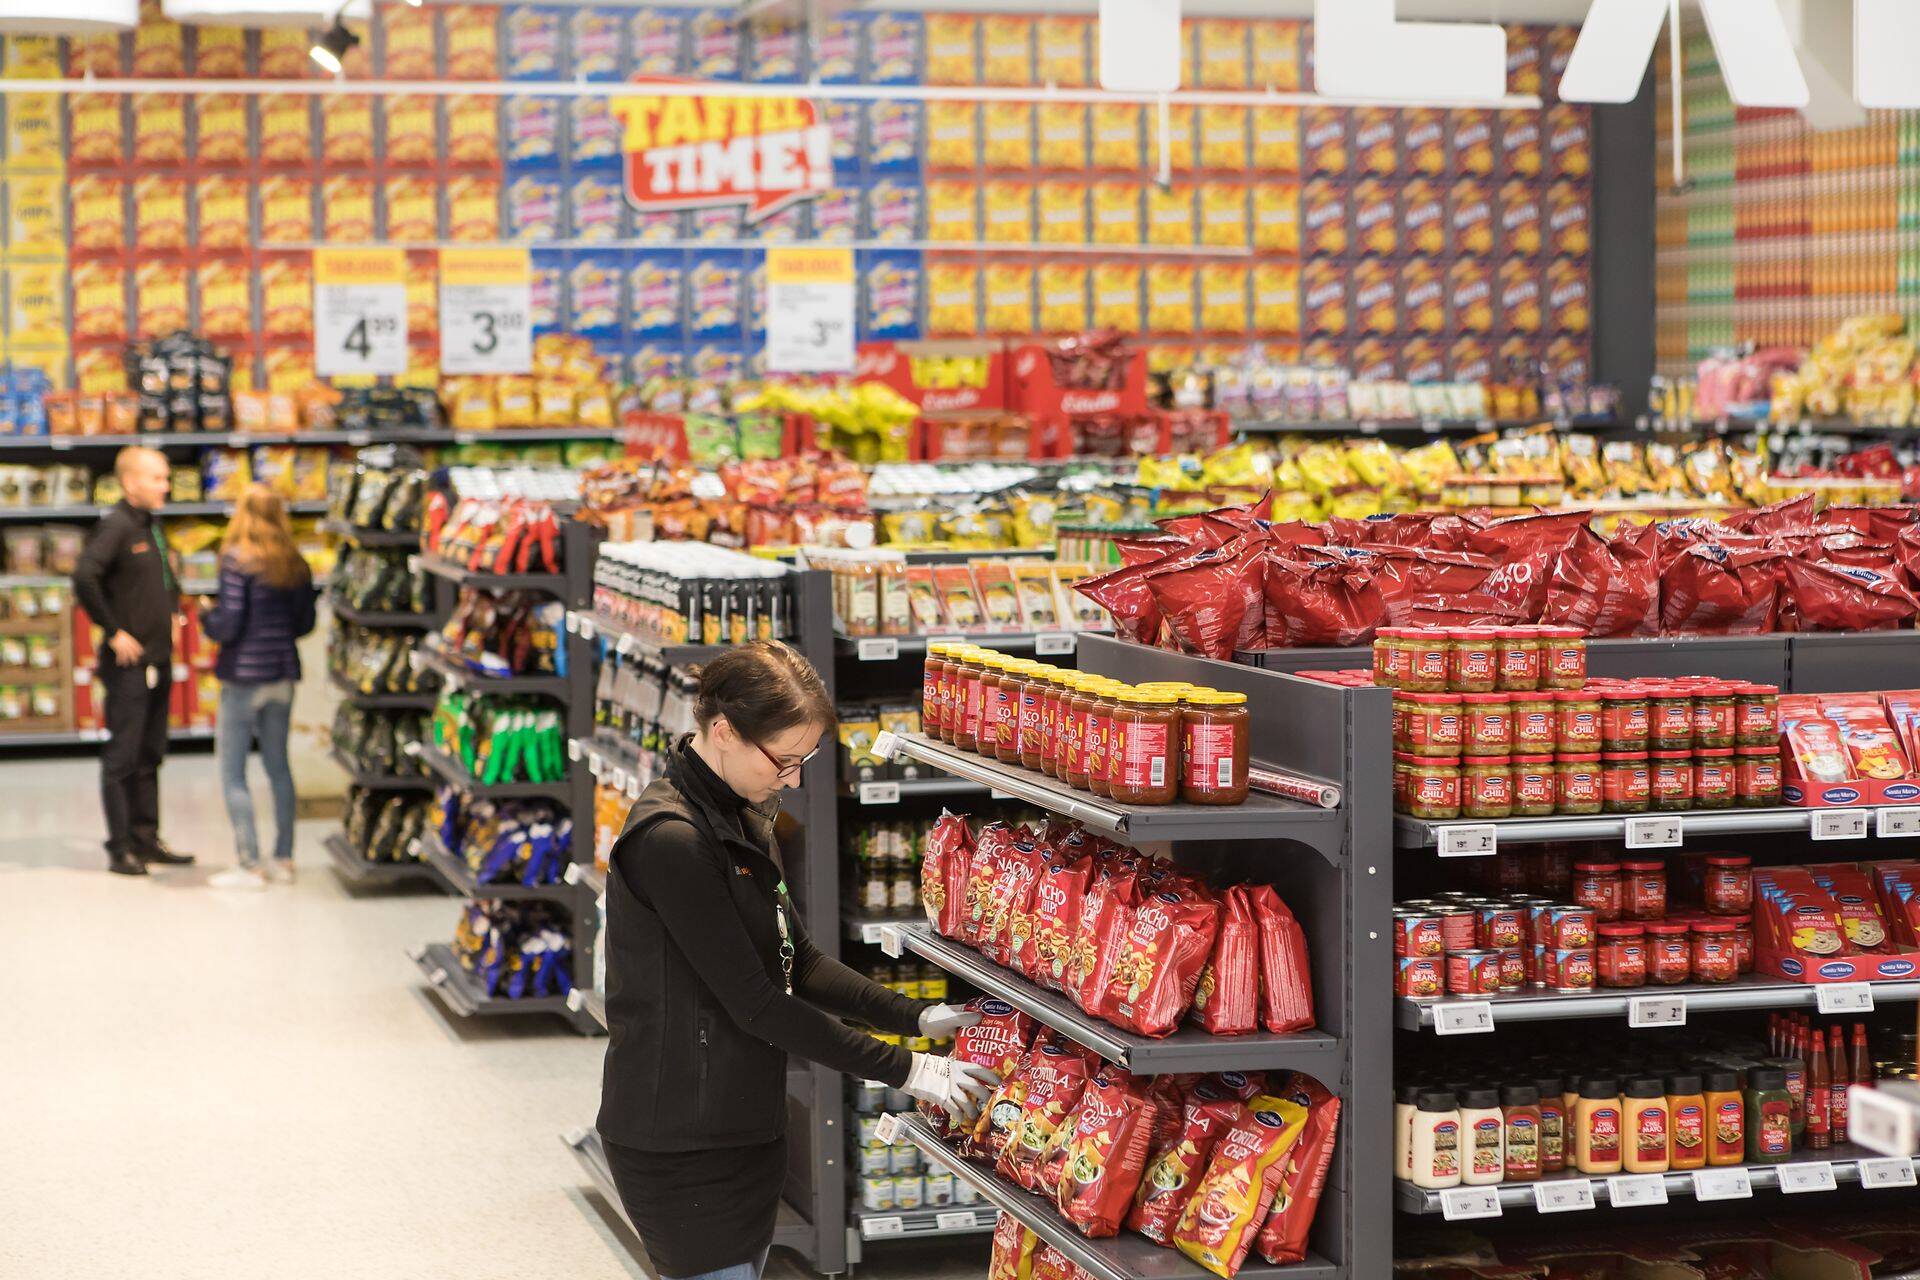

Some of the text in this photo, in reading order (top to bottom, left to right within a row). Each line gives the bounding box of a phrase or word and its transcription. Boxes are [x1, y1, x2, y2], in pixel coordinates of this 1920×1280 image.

[643, 124, 832, 192] TIME!
[1422, 665, 1443, 673] CHILI
[1467, 665, 1488, 673] CHILI
[1505, 663, 1528, 671] CHILI
[1559, 662, 1580, 670] CHILI
[1438, 728, 1458, 736] CHILI
[1482, 728, 1504, 736] CHILI
[1525, 726, 1547, 734] CHILI
[1573, 726, 1595, 734] CHILI
[1421, 790, 1443, 798] CHILI
[1522, 787, 1544, 795] CHILI
[1571, 786, 1593, 794] CHILI
[1134, 905, 1169, 931] NACHO
[1134, 920, 1157, 941] CHIPS
[1495, 926, 1519, 935] BEANS
[1562, 927, 1588, 936] BEANS
[1418, 935, 1441, 943] BEANS
[1502, 964, 1524, 972] BEANS
[1569, 965, 1592, 974] BEANS
[1412, 973, 1437, 982] BEANS
[960, 1026, 1021, 1047] TORTILLA
[966, 1039, 1006, 1057] CHIPS
[970, 1053, 995, 1067] CHILI
[1041, 1250, 1066, 1272] CHIPS
